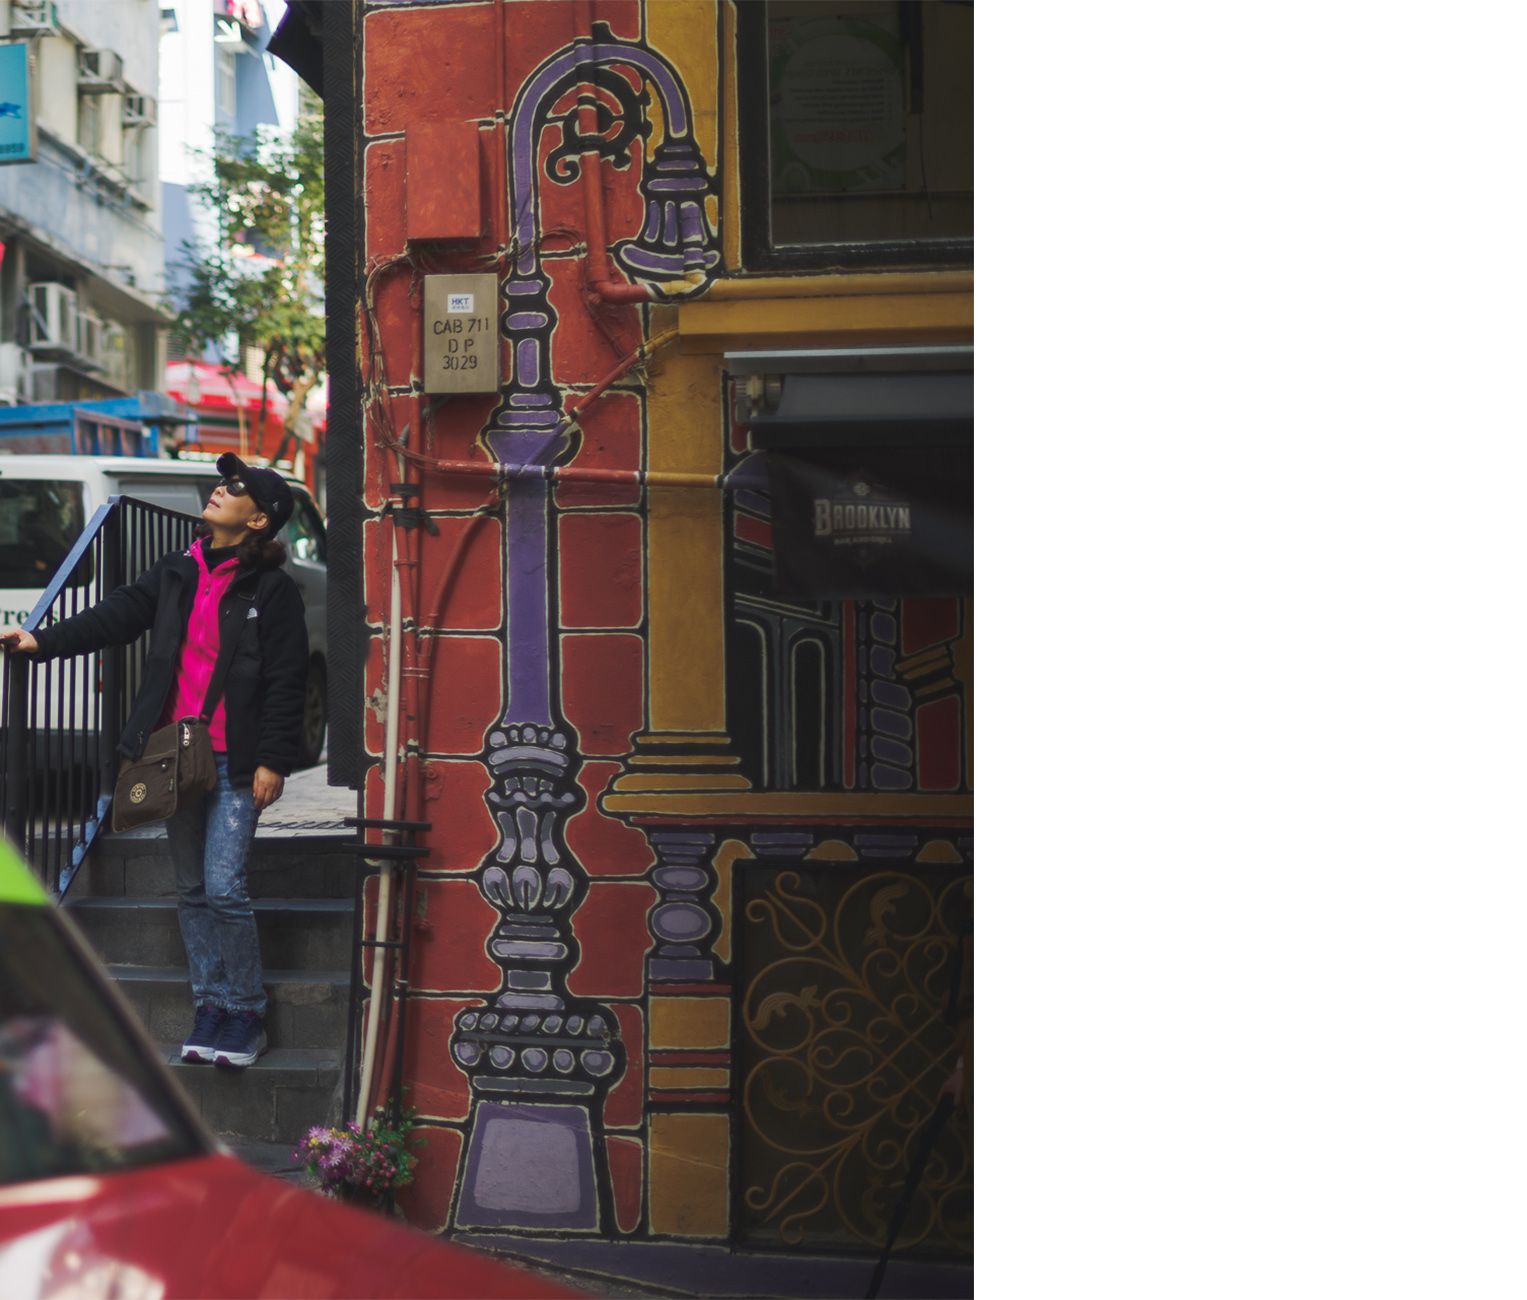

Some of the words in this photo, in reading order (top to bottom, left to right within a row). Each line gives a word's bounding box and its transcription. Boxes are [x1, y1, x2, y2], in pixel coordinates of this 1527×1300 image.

[433, 319, 463, 335] CAB
[468, 317, 489, 333] 711
[448, 339, 458, 353] D
[465, 339, 474, 353] P
[442, 355, 478, 371] 3029
[814, 499, 911, 537] BROOKLYN
